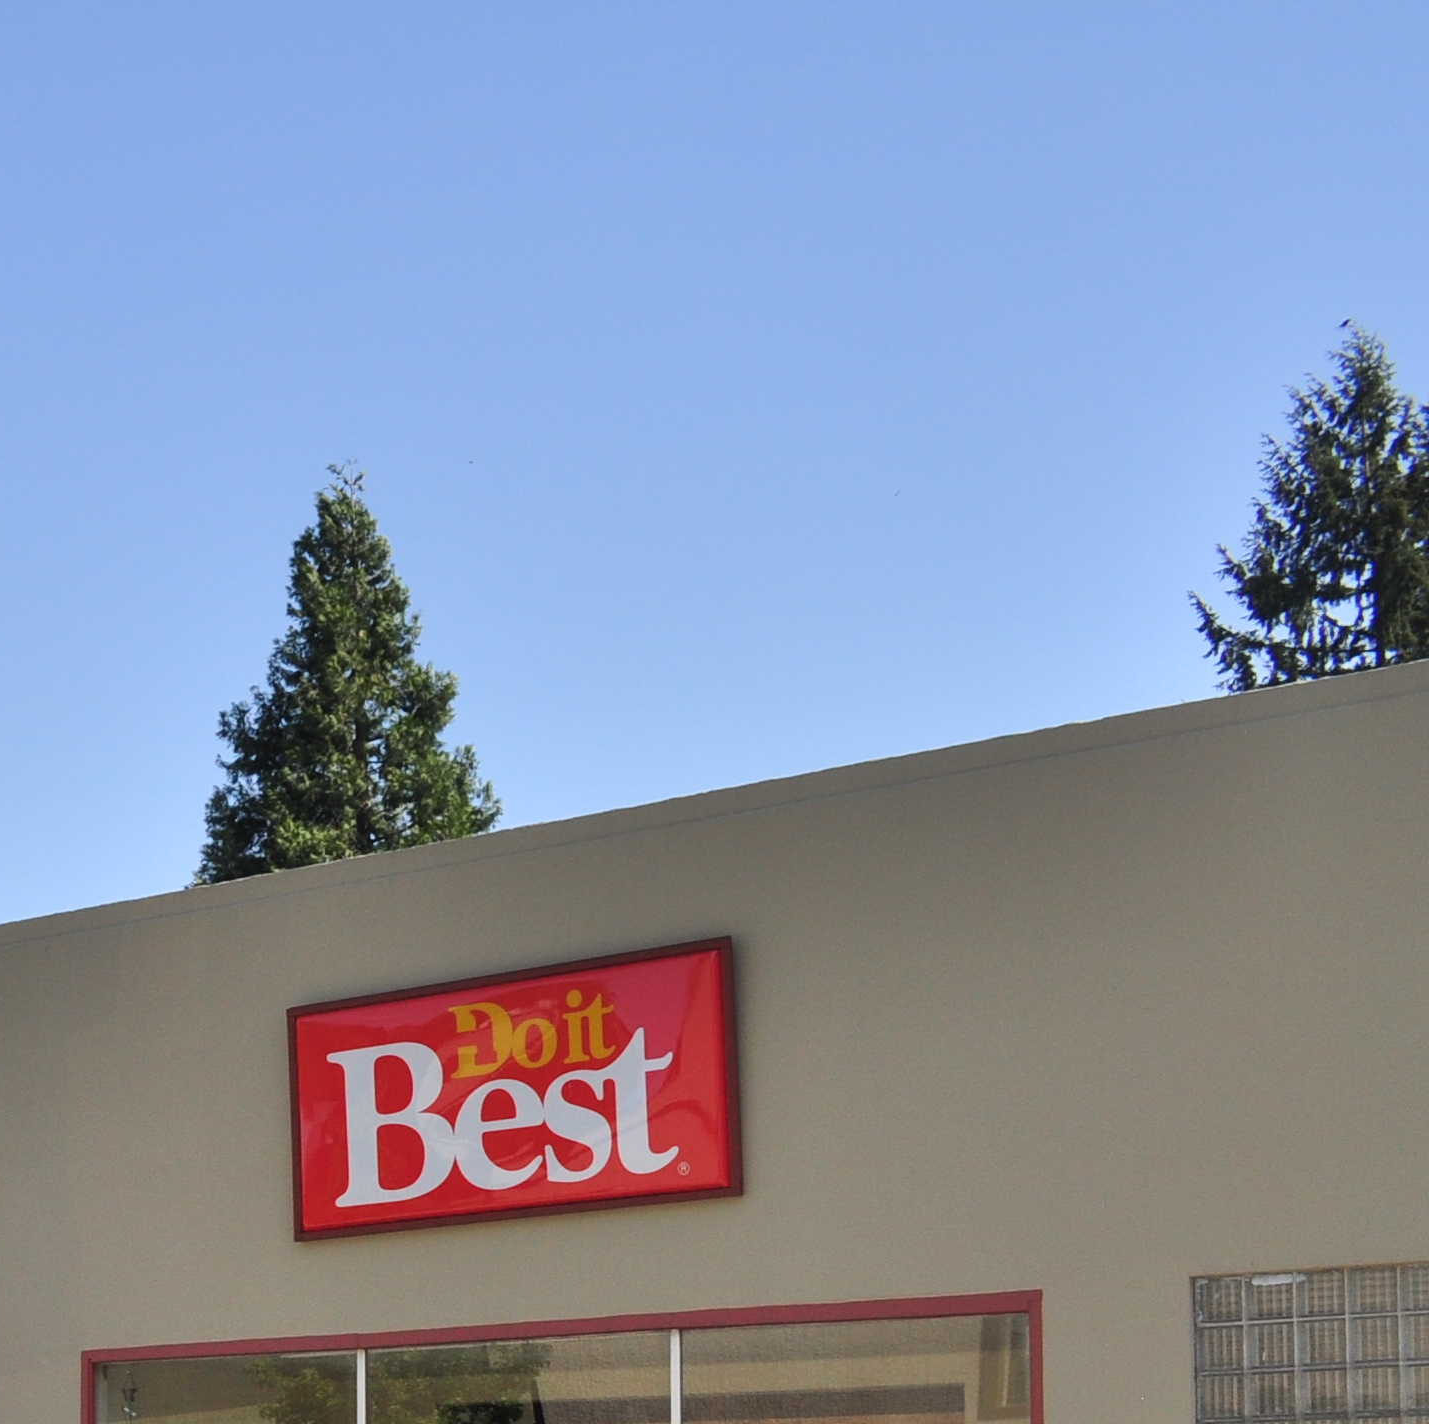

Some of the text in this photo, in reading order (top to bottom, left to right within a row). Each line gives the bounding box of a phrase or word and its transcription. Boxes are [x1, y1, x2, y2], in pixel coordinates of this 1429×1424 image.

[449, 989, 617, 1079] Do it
[327, 1027, 680, 1208] Best
